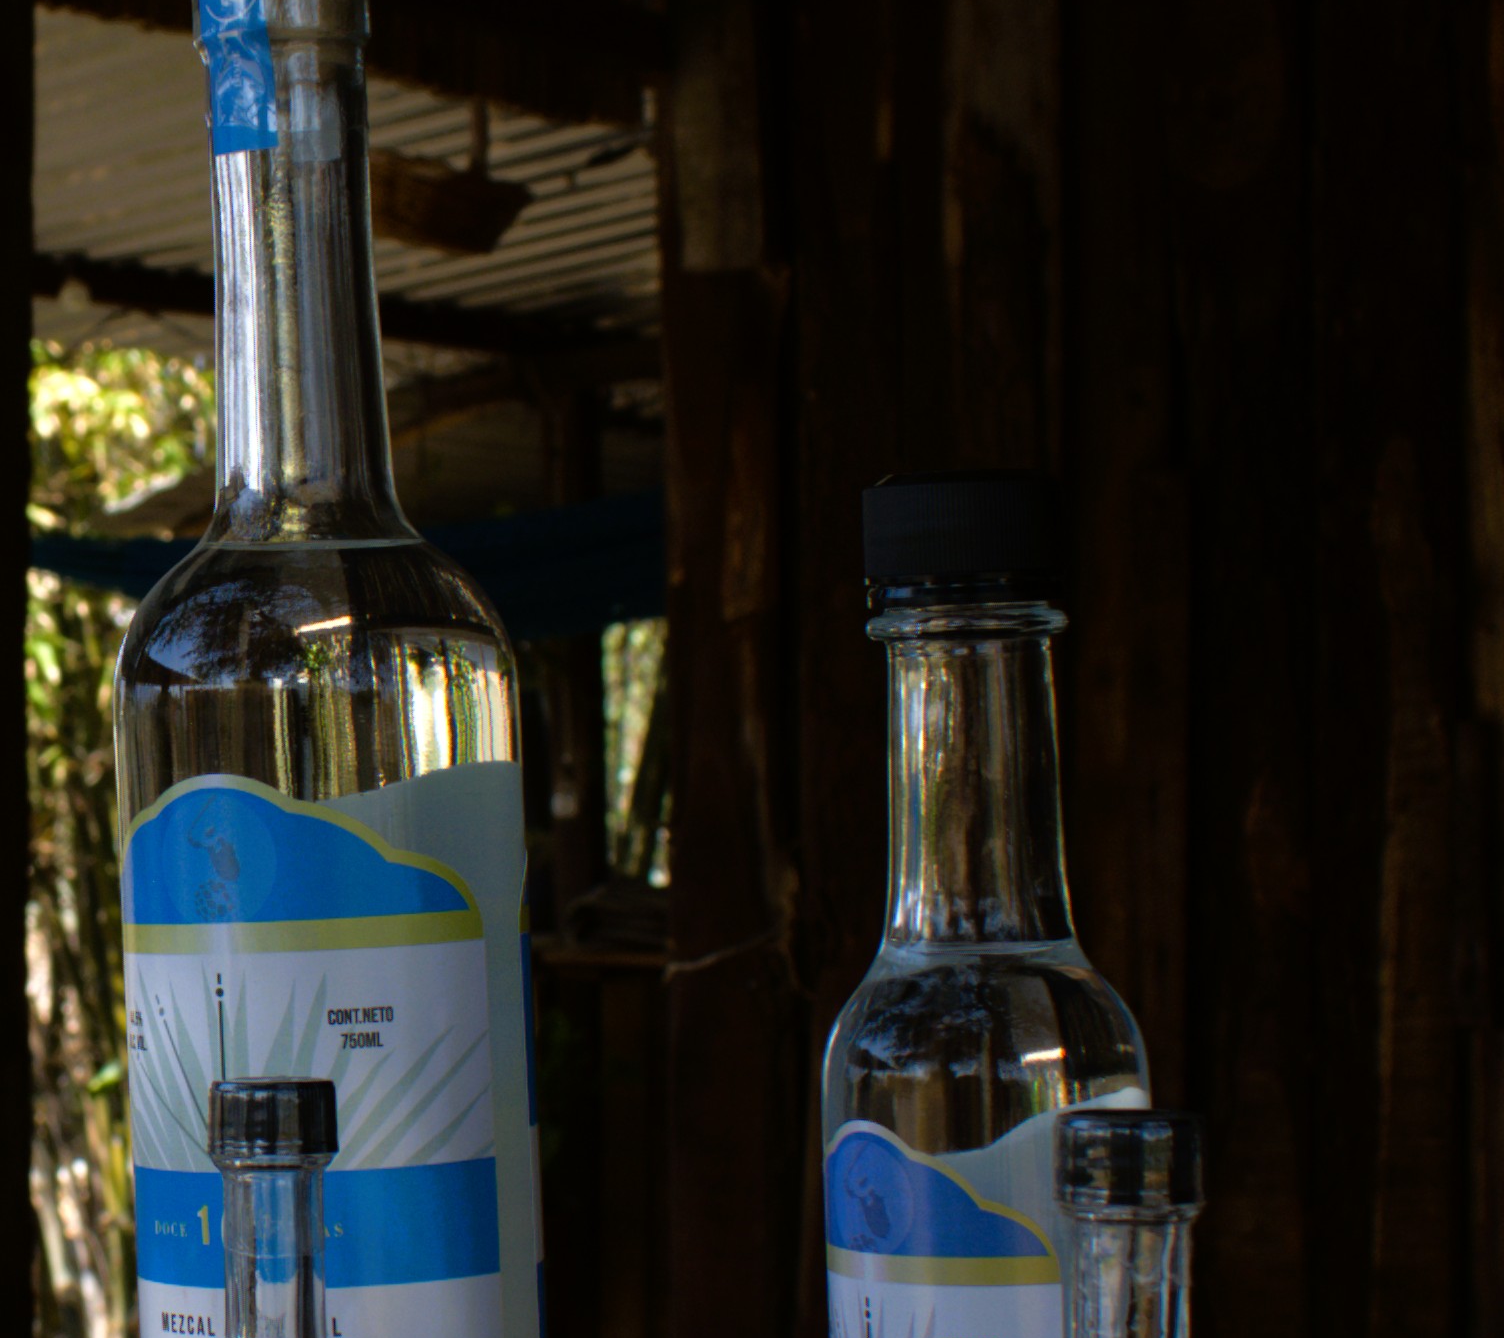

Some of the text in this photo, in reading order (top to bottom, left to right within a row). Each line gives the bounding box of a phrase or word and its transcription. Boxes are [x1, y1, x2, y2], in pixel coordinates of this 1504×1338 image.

[327, 1006, 394, 1026] CONT.NETO
[340, 1032, 384, 1050] 750ML
[154, 1220, 188, 1238] DOCE
[161, 1312, 215, 1337] MEZCAL
